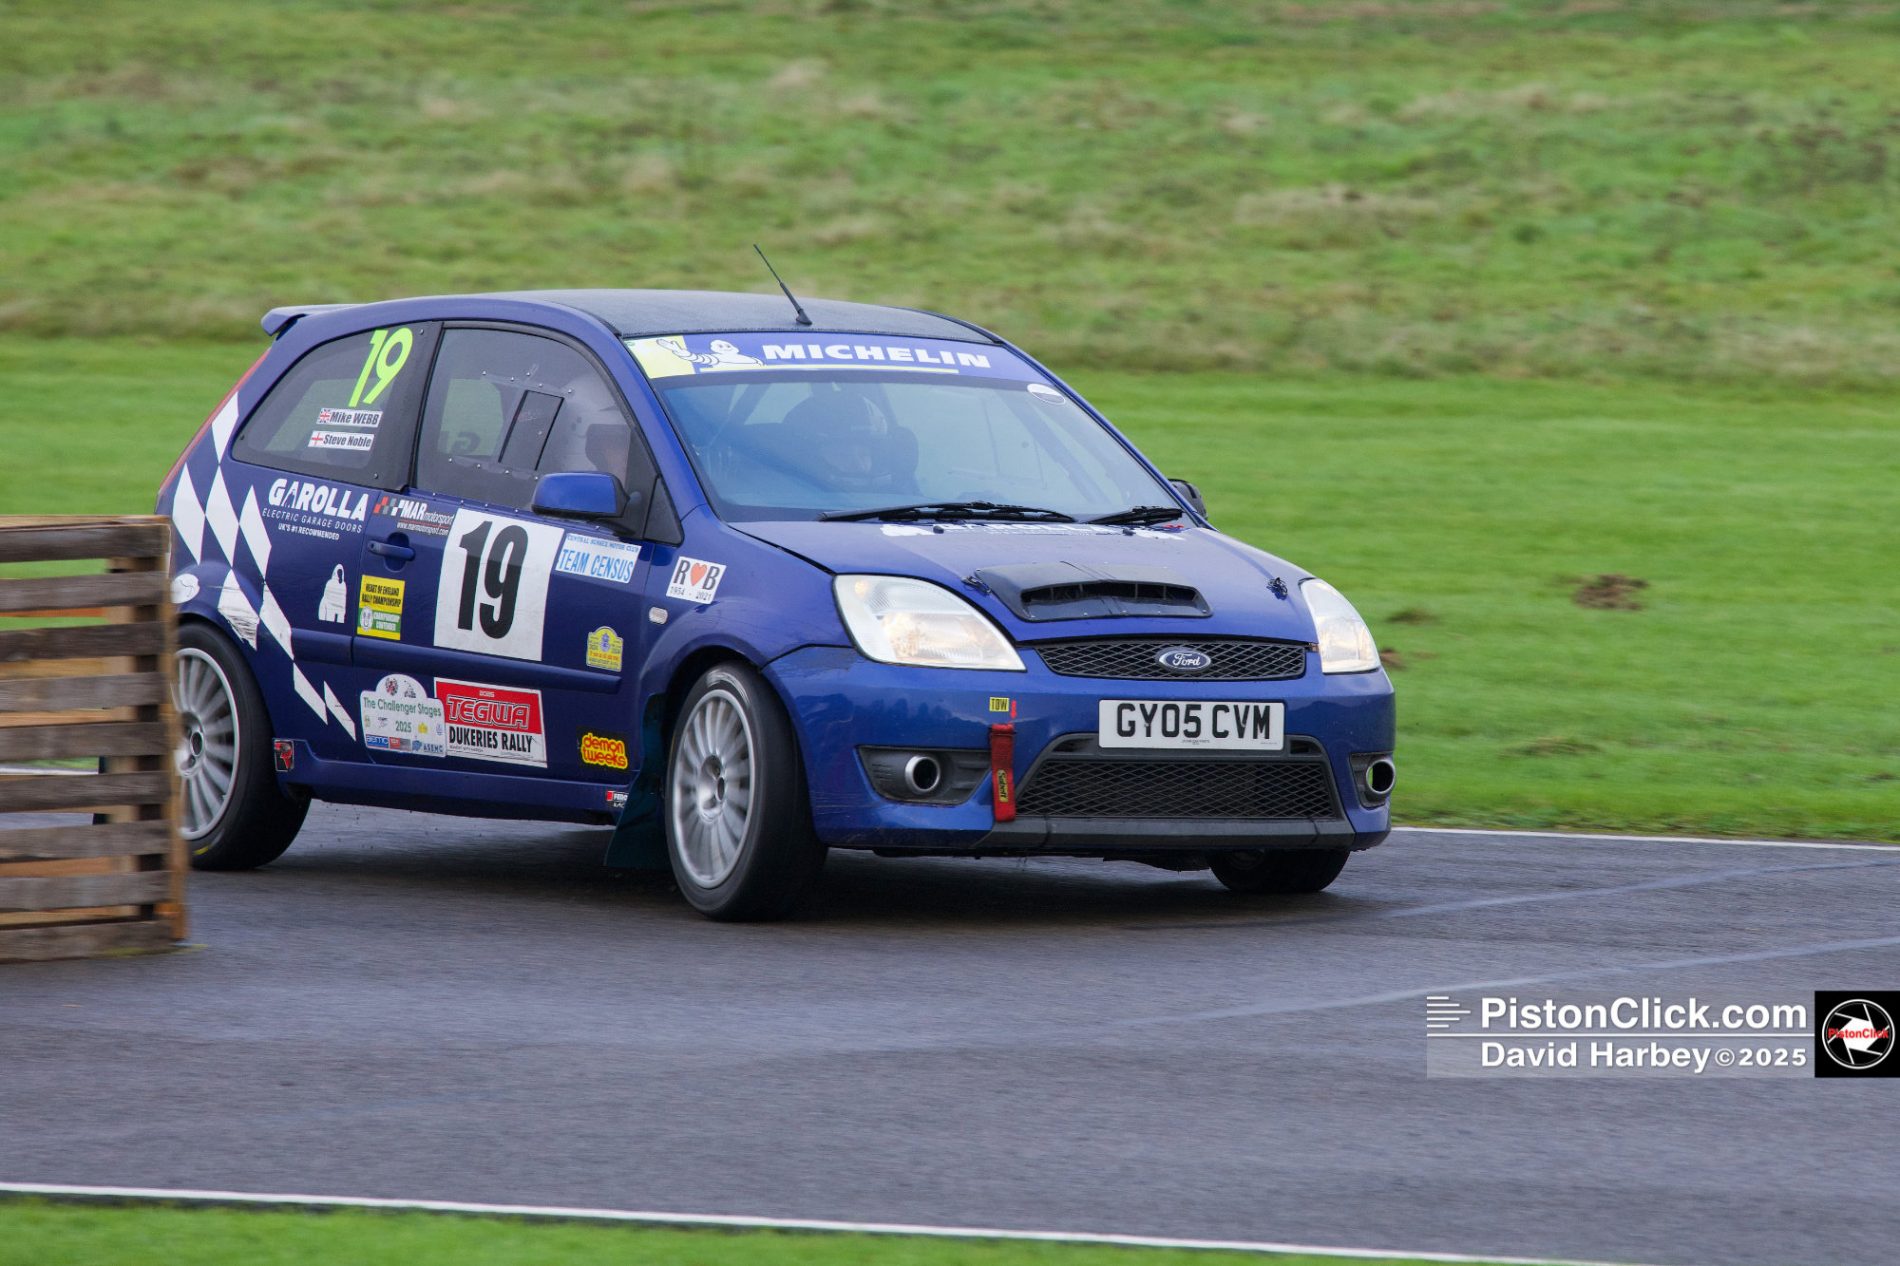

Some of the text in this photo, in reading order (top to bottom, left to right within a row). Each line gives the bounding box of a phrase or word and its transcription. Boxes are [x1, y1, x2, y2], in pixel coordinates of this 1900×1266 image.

[348, 327, 413, 408] 19
[762, 344, 991, 368] MICHELIN
[330, 411, 380, 425] Mike WEBB
[323, 434, 372, 447] Steve Noble
[268, 478, 369, 521] GAROLLA
[262, 508, 362, 534] ELECTRIC GARAGE DOORS
[298, 527, 340, 540] RECOMMENDED
[559, 549, 634, 581] TEAM CENSUS
[673, 560, 720, 590] R B
[458, 520, 529, 639] 19
[1172, 652, 1201, 666] Ford
[363, 697, 442, 718] The Challenger Stages
[447, 694, 530, 729] TEGIWA
[991, 698, 1008, 711] TOW
[395, 720, 412, 732] 2025
[1117, 703, 1270, 739] GY05 CVM
[449, 726, 533, 753] DUKERIES RALLY
[582, 733, 625, 756] demon
[582, 746, 628, 769] tweeks
